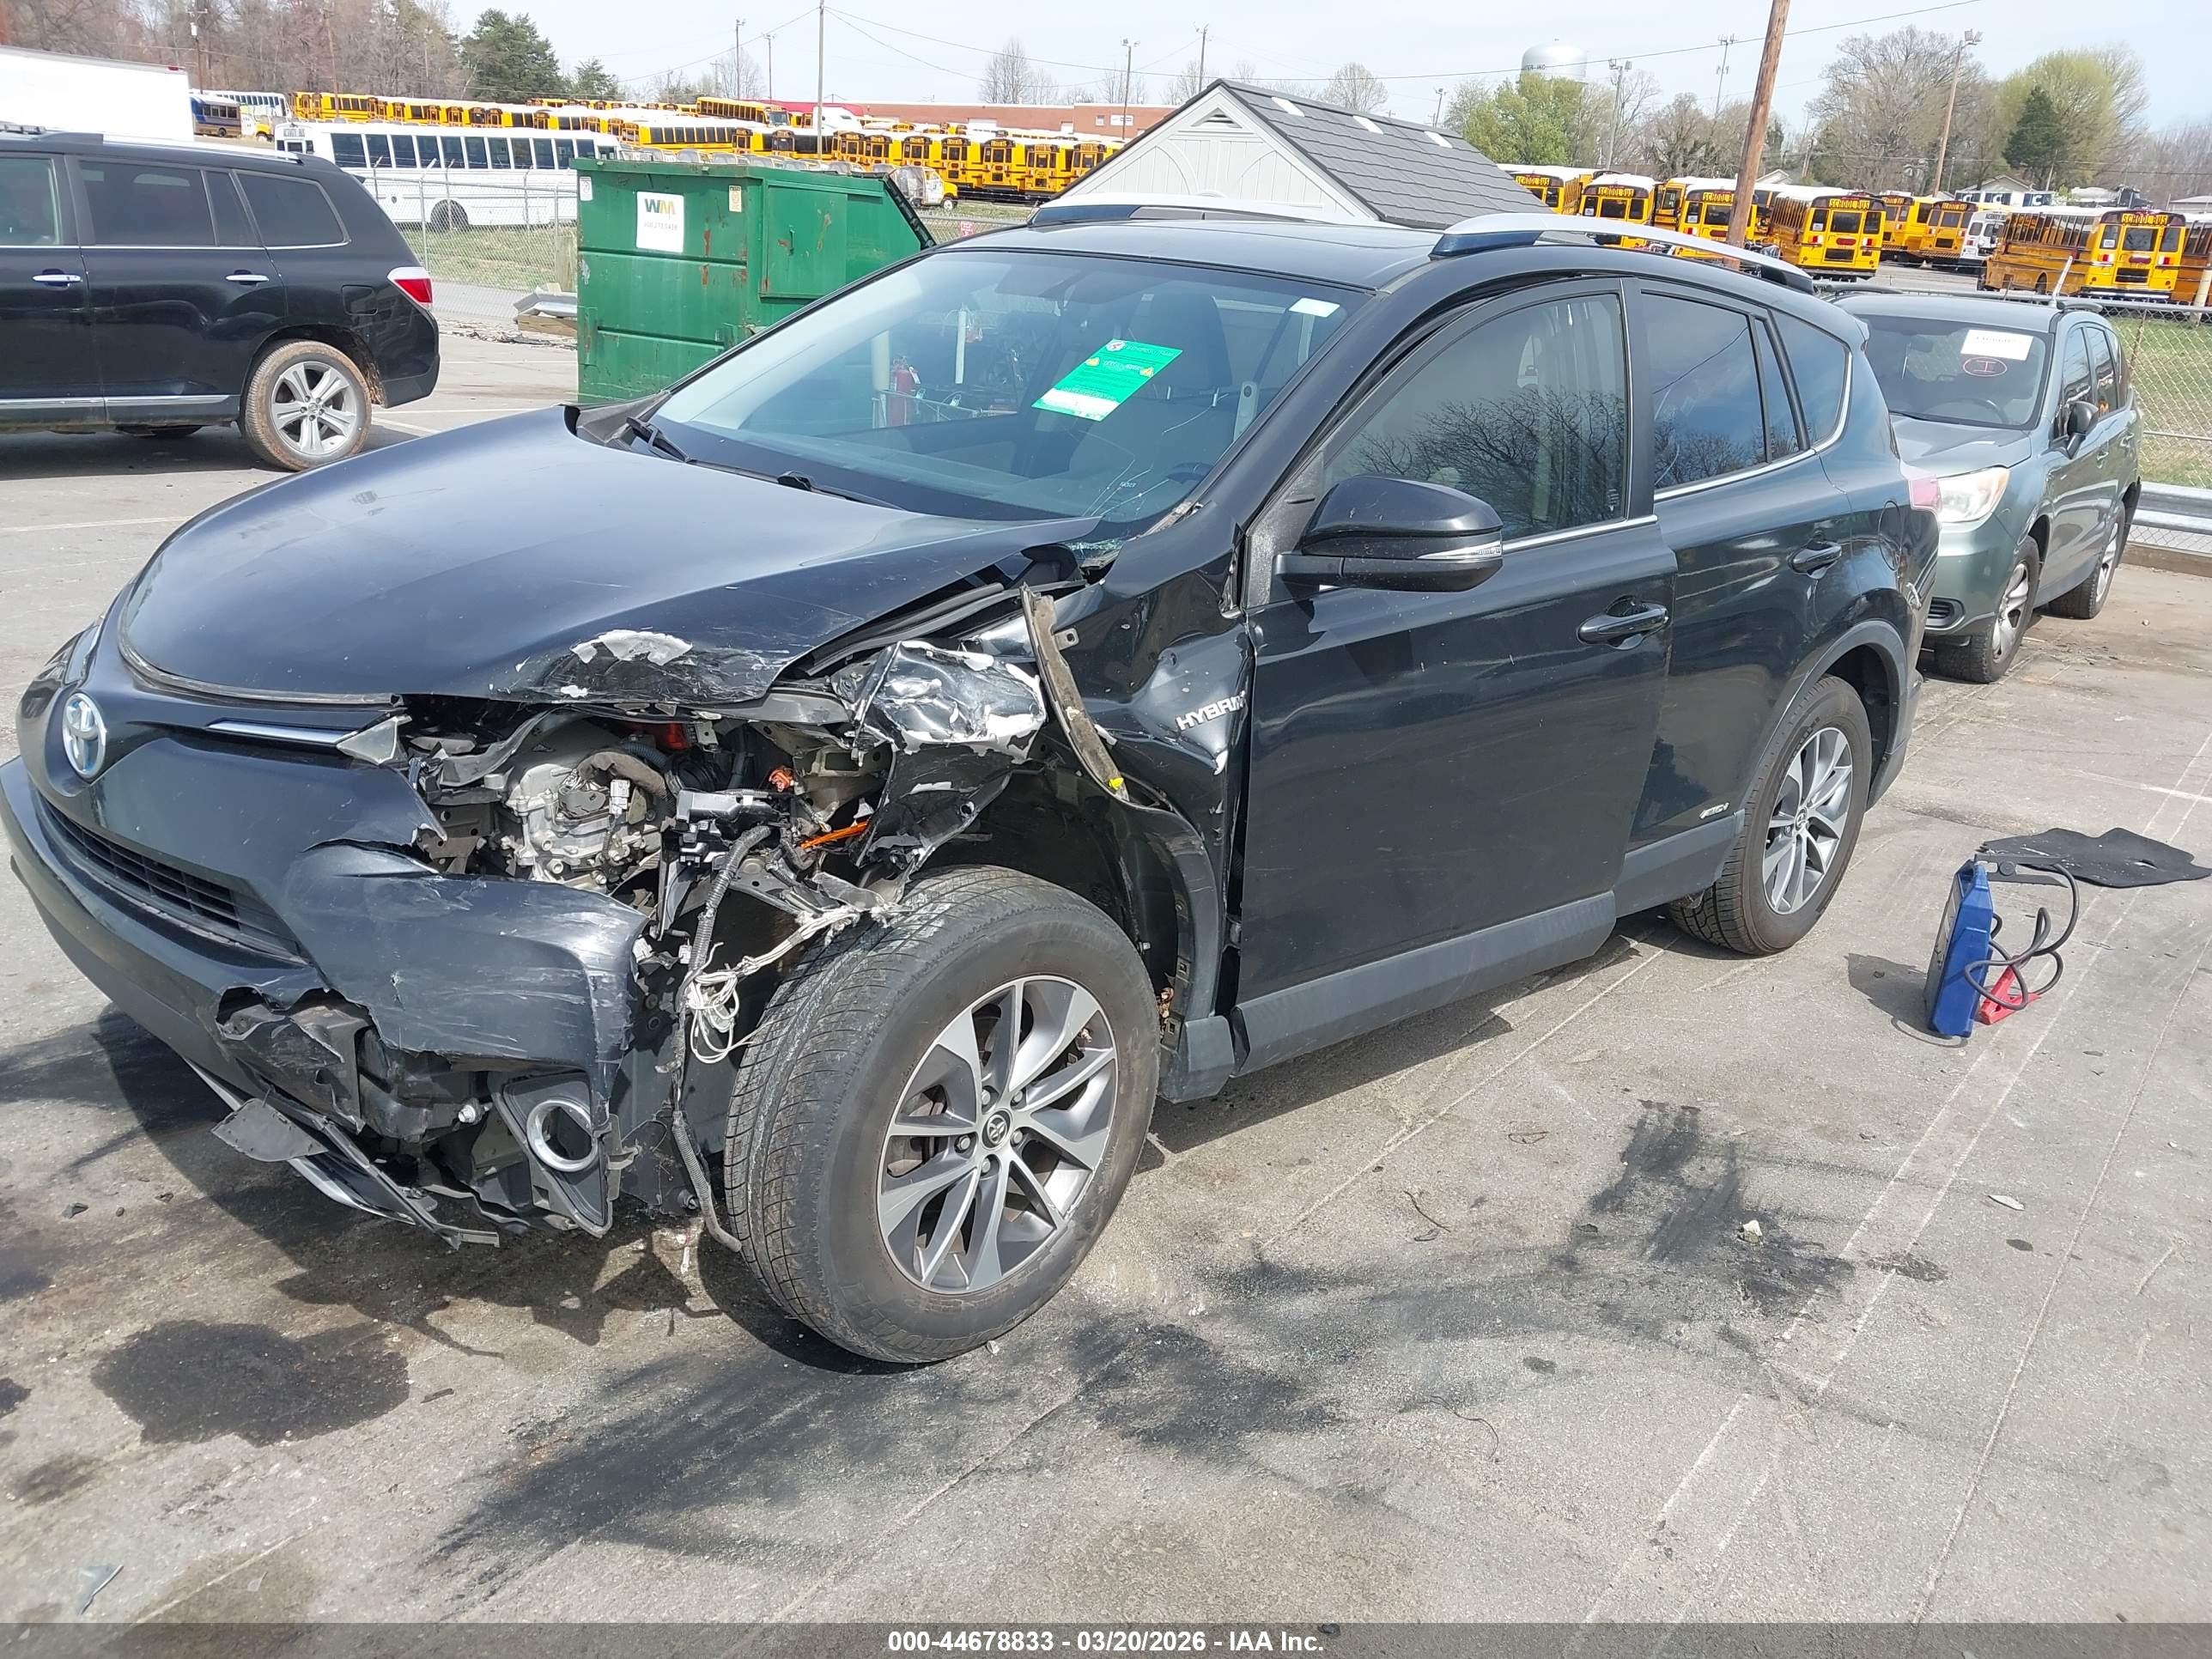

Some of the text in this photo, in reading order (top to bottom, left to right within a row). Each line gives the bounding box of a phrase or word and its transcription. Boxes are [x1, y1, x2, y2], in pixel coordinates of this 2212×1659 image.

[643, 198, 675, 215] WM
[1830, 198, 1855, 209] SCHOO
[2123, 214, 2152, 224] SCHOO
